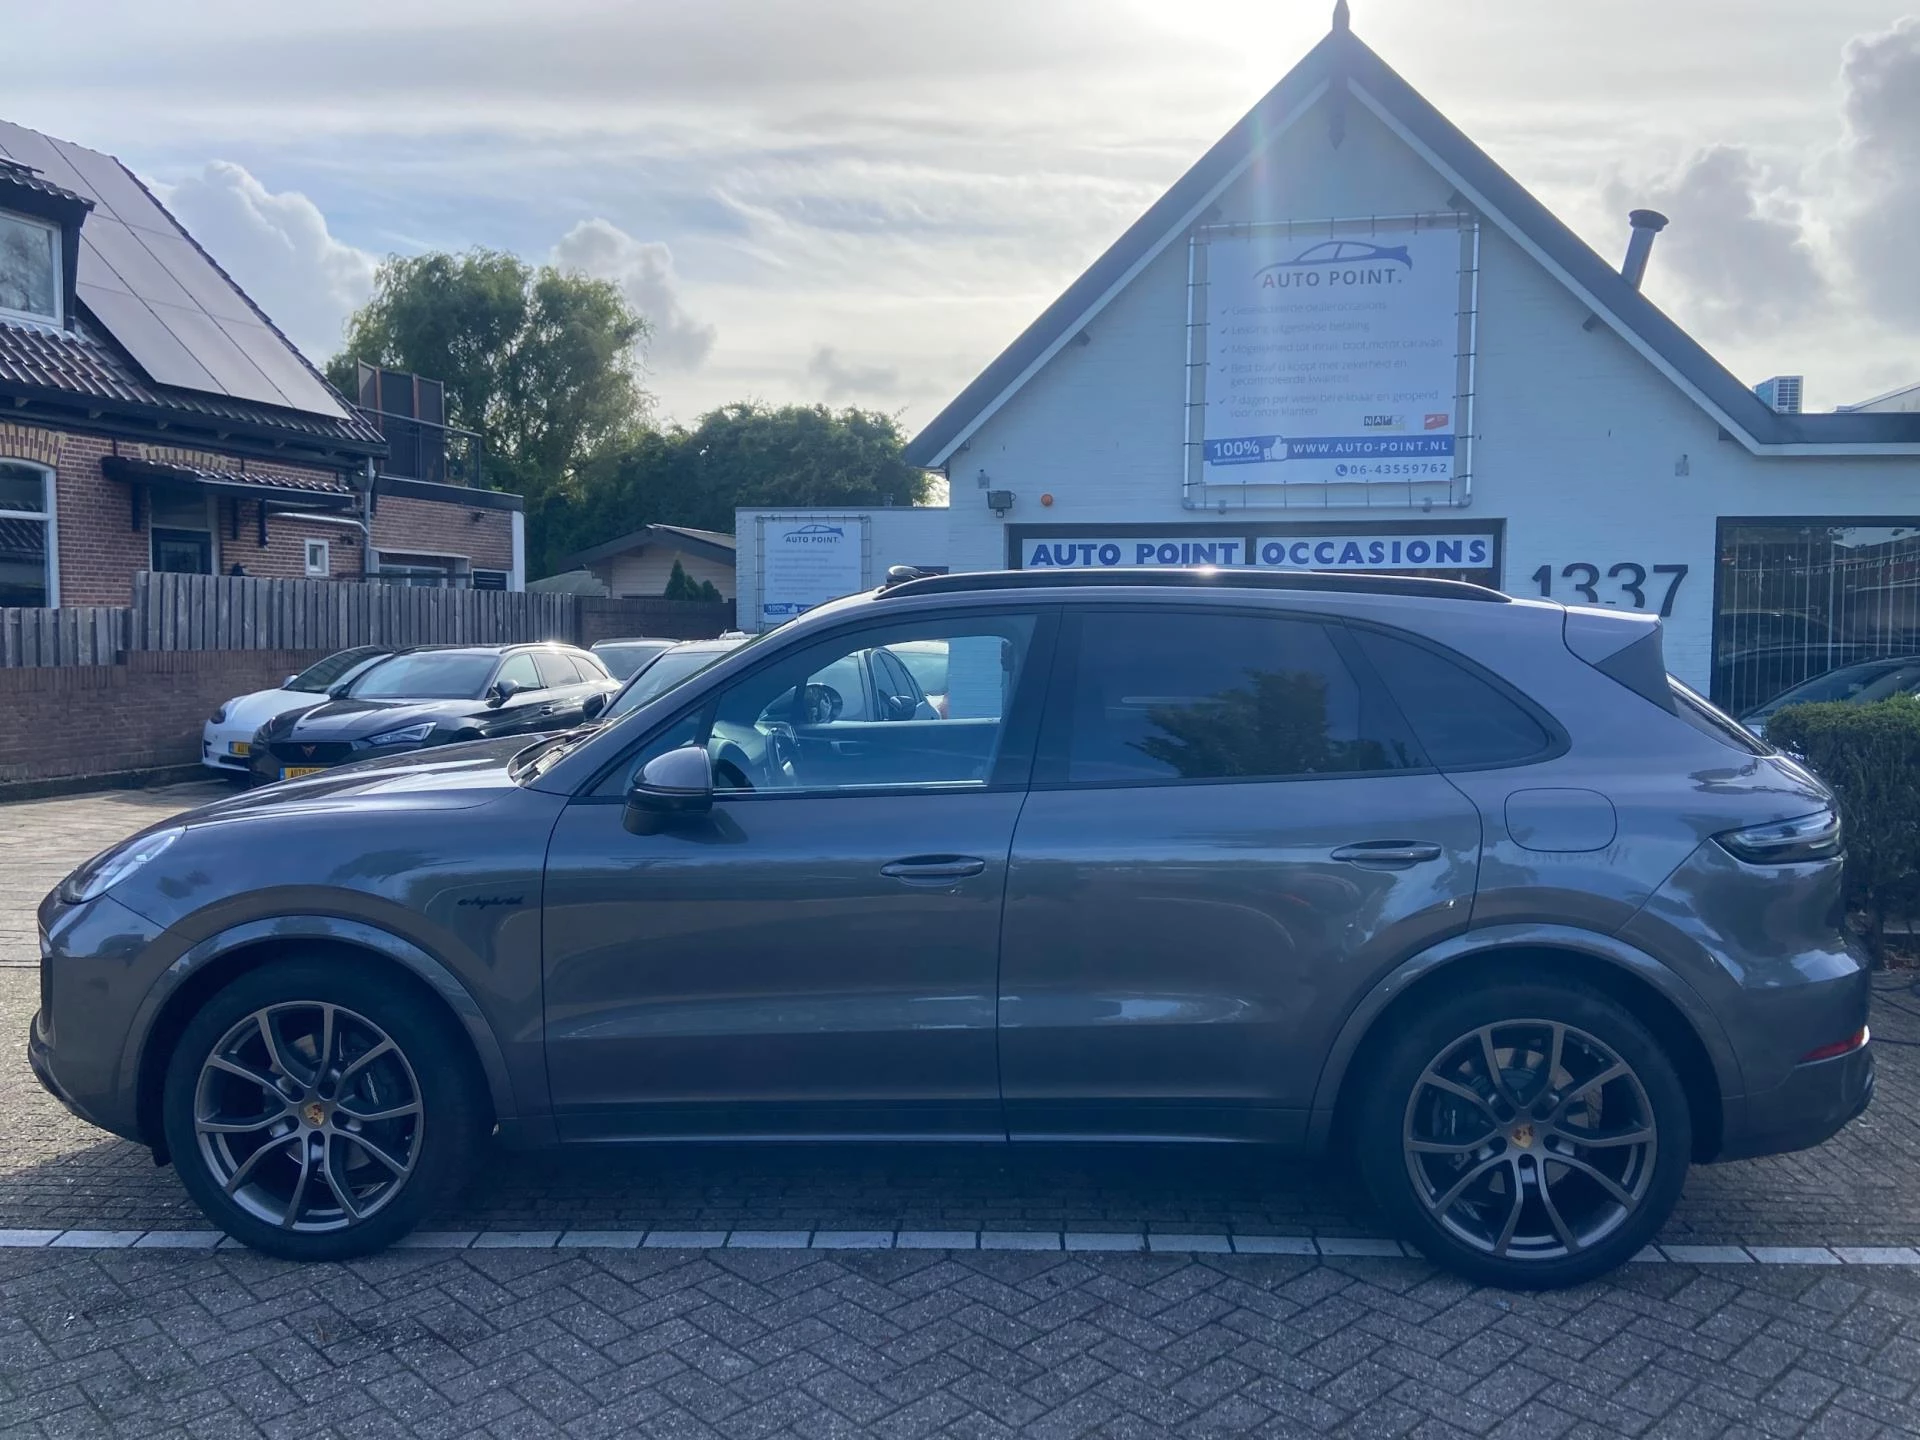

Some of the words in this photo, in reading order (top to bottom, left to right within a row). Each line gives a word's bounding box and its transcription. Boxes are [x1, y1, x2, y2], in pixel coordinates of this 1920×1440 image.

[1262, 271, 1321, 288] AUTO
[1213, 440, 1260, 458] 100%
[1292, 441, 1448, 454] WWW.AUTO-POINT.NL
[1350, 463, 1448, 475] 06-43559762
[1030, 543, 1121, 566] AUTO
[1136, 542, 1239, 565] POINT
[1262, 540, 1486, 565] OCCASIONS
[1532, 562, 1689, 618] 1337
